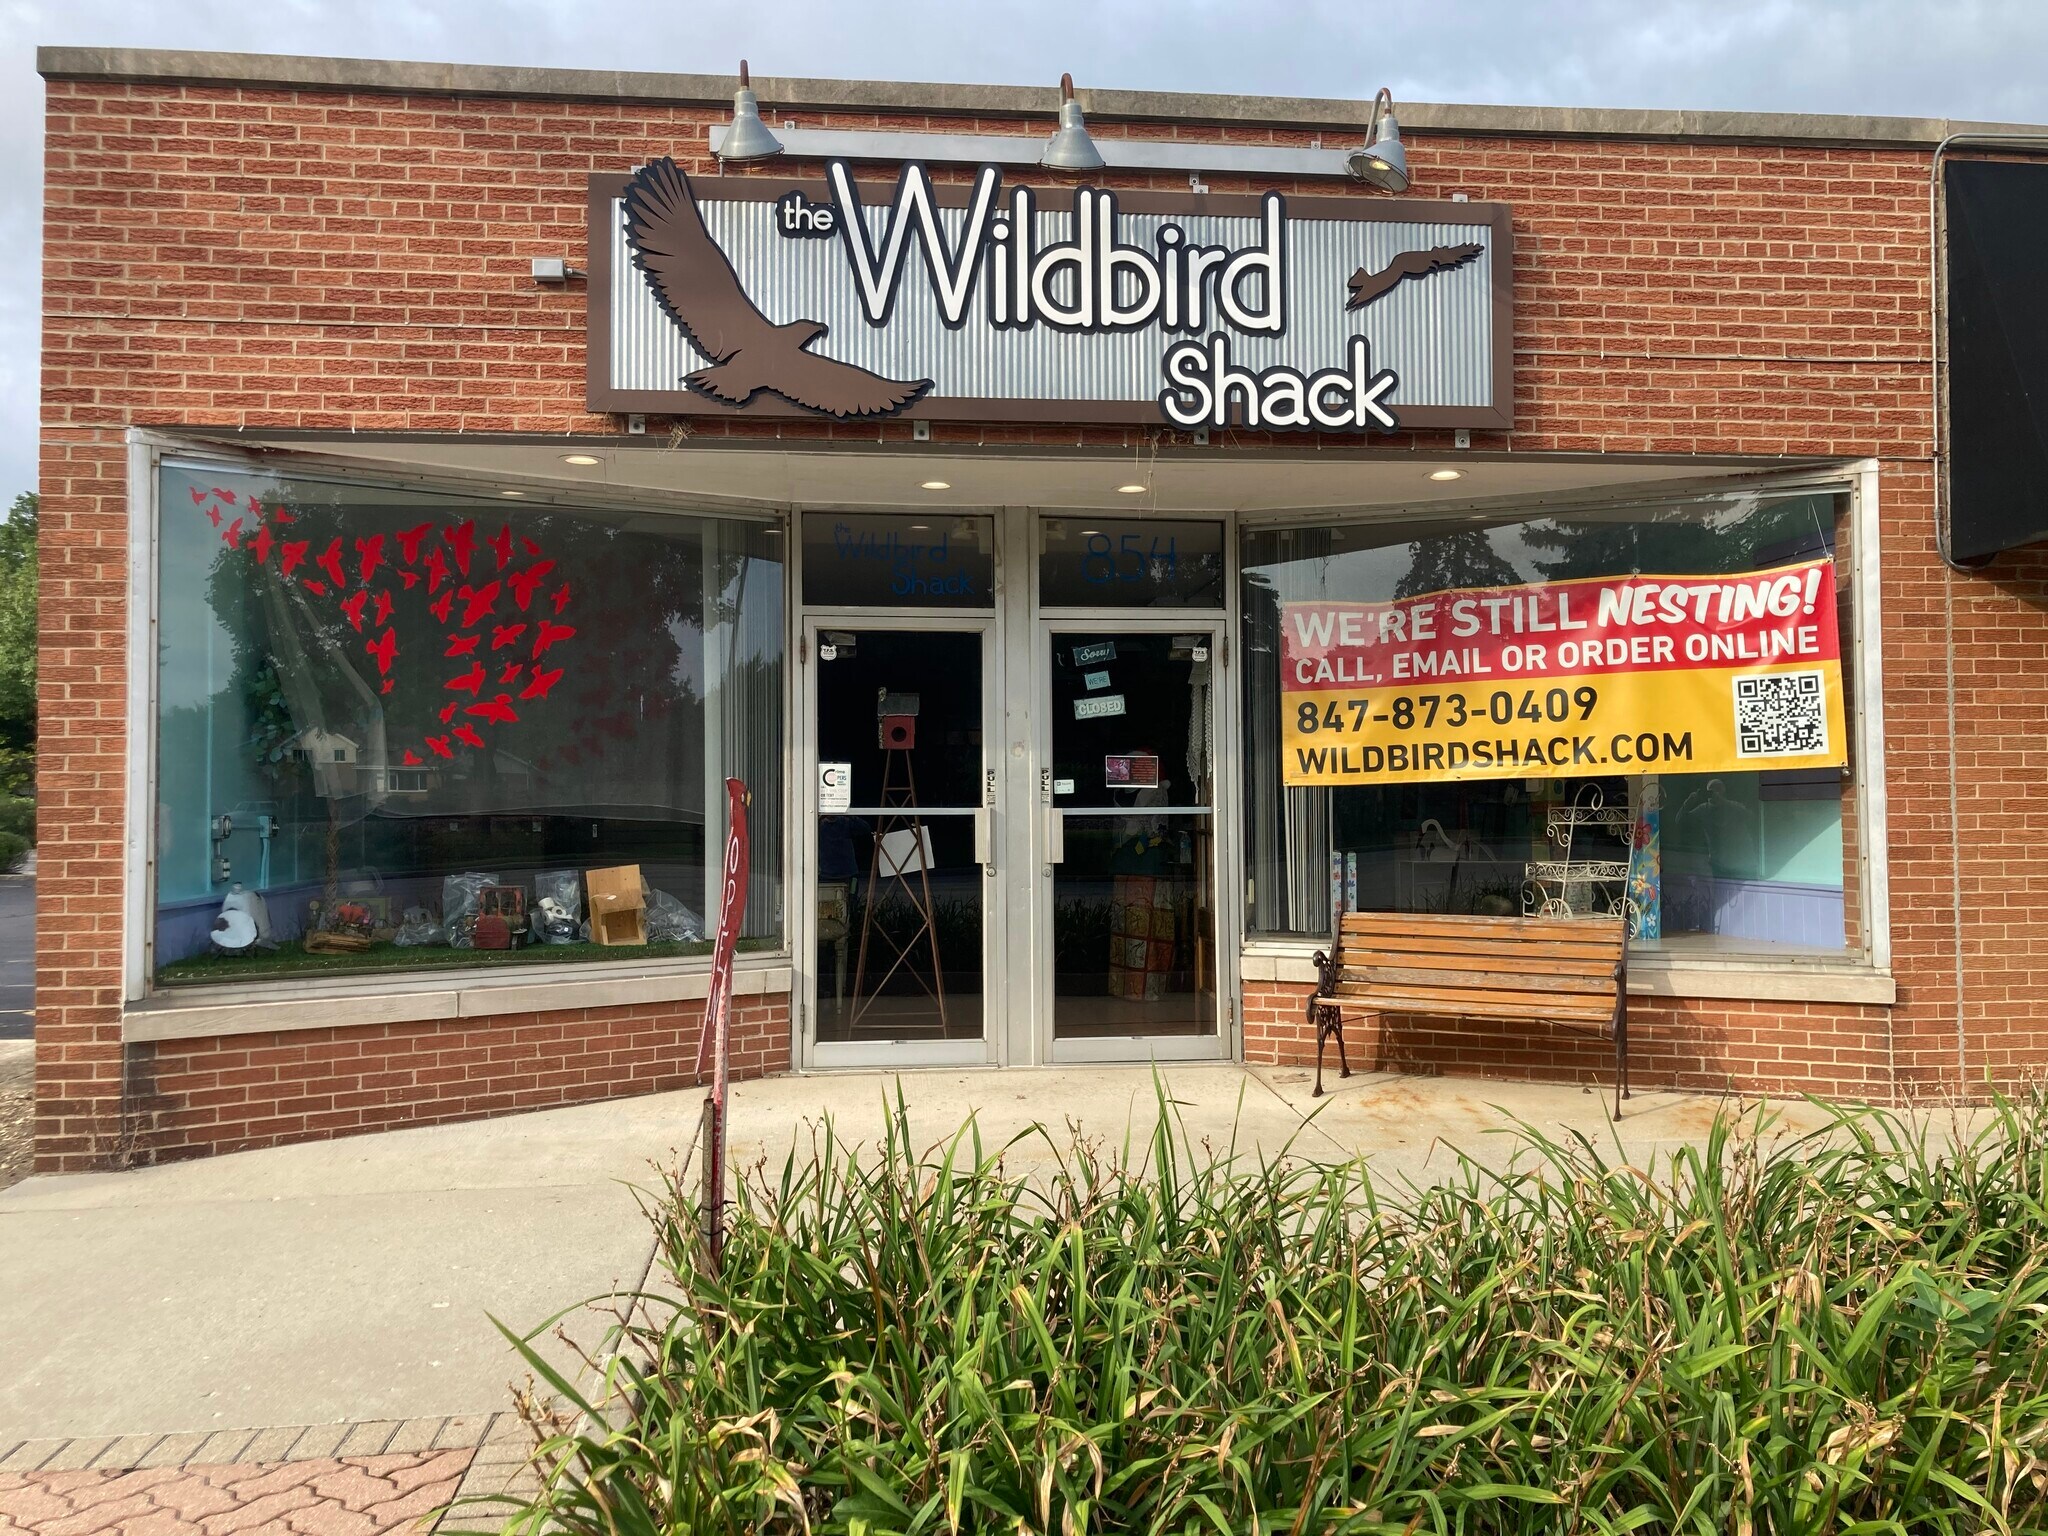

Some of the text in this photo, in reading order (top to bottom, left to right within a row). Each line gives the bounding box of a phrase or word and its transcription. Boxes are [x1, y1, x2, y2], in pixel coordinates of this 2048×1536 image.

[784, 163, 1280, 332] the Wildbird
[1165, 338, 1395, 427] Shack
[891, 566, 975, 596] Shack
[1081, 533, 1176, 583] 854
[1294, 568, 1822, 648] WE'RE STILL NESTING!
[1080, 648, 1110, 661] Sorry
[1295, 625, 1820, 684] CALL, EMAIL OR ORDER ONLINE
[1079, 700, 1122, 715] CLOSED
[1299, 686, 1599, 734] 847-873-0409
[1296, 731, 1694, 775] WILDBIRDSHACK.COM
[987, 770, 995, 793] PULL
[1041, 769, 1050, 792] PULL
